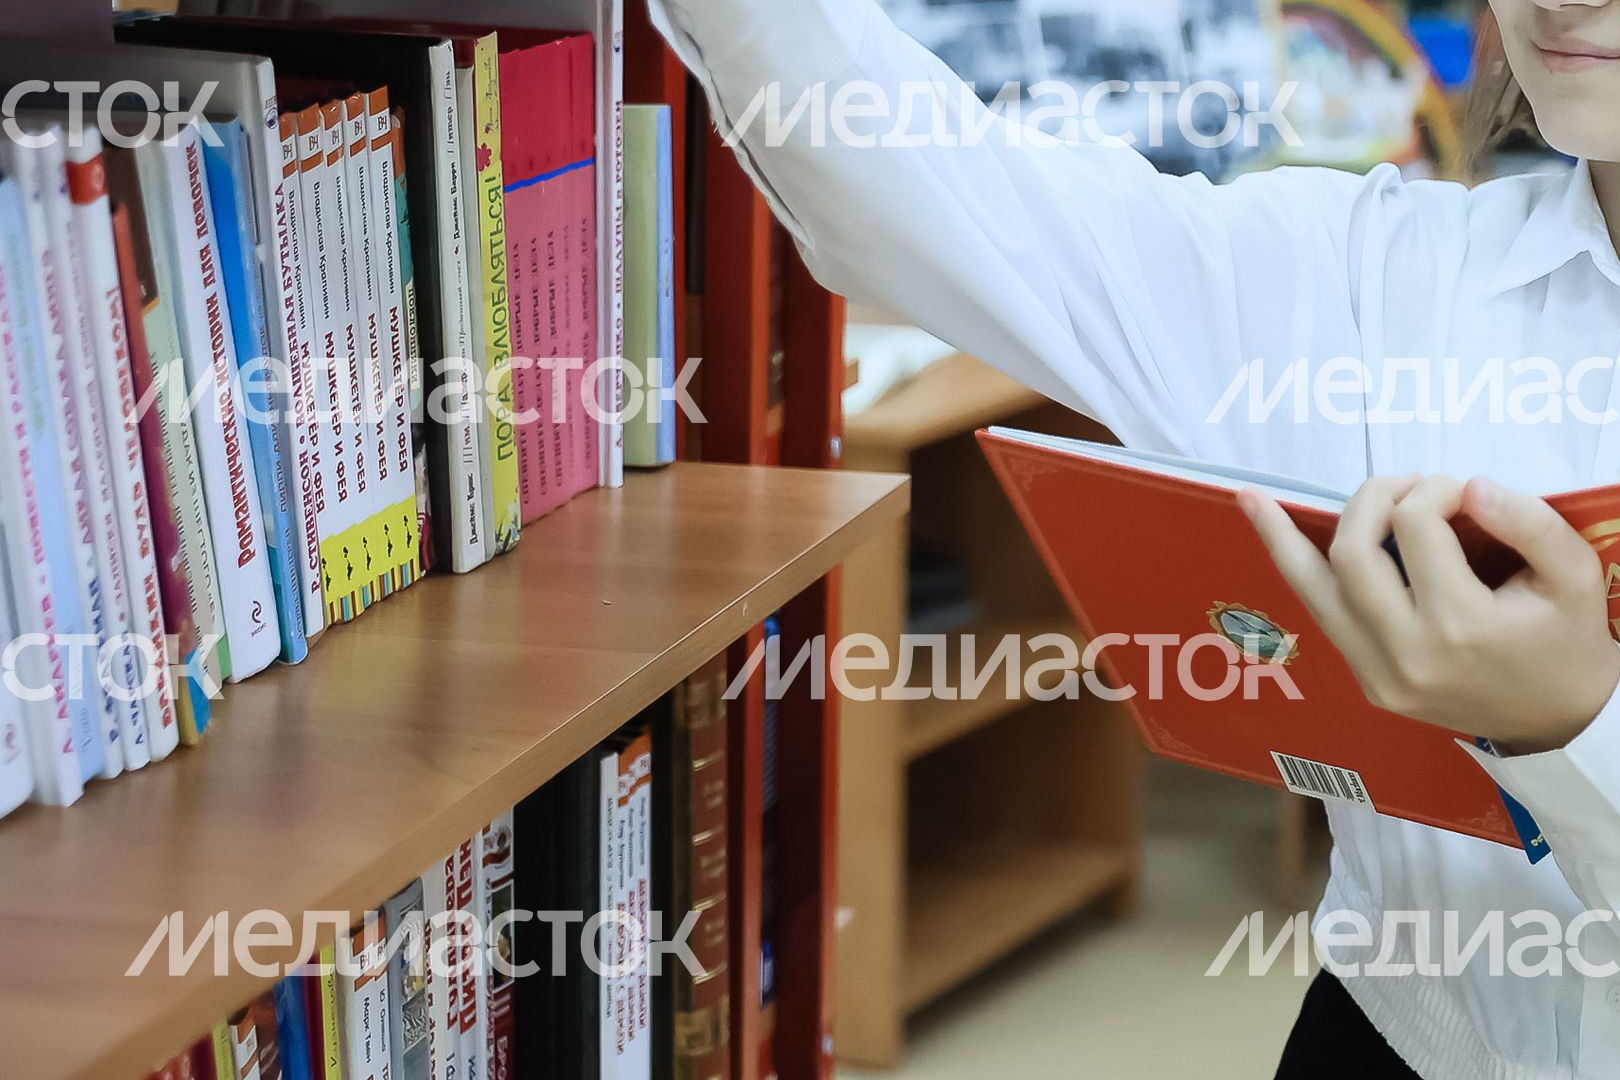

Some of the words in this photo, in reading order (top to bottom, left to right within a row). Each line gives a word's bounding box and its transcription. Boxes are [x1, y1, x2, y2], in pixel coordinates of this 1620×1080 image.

[286, 189, 301, 263] Владислав
[311, 180, 326, 252] Владислав
[332, 175, 346, 246] Владислав
[356, 165, 369, 236] Владислав
[379, 159, 393, 230] Владислав
[272, 181, 294, 291] БУТЫЛКА
[361, 235, 375, 301] Крапивин
[384, 230, 398, 295] Крапивин
[292, 263, 308, 330] Крапивин
[317, 254, 332, 319] Крапивин
[338, 246, 352, 312] Крапивин
[483, 173, 509, 372] ВЛЮБЛЯТЬСЯ!
[283, 292, 306, 427] ВОЛШЕБНАЯ
[323, 330, 343, 437] МУШКЕТЁР
[343, 323, 362, 428] МУШКЕТЁР
[365, 312, 383, 416] МУШКЕТЁР
[386, 306, 405, 408] МУШКЕТЁР
[299, 341, 320, 447] МУШКЕТЁР
[394, 411, 406, 426] И
[494, 385, 513, 460] ПОРА
[309, 450, 321, 466] И
[332, 439, 345, 456] И
[353, 430, 364, 448] И
[373, 420, 385, 436] И
[375, 439, 389, 482] ФЕЯ
[396, 428, 410, 473] ФЕЯ
[311, 468, 326, 514] ФЕЯ
[334, 459, 349, 503] ФЕЯ
[354, 449, 368, 494] ФЕЯ
[297, 449, 319, 570] СТИВЕНСОН
[454, 836, 474, 906] Пэн
[359, 996, 372, 1034] Марк
[362, 1036, 374, 1064] Твен
